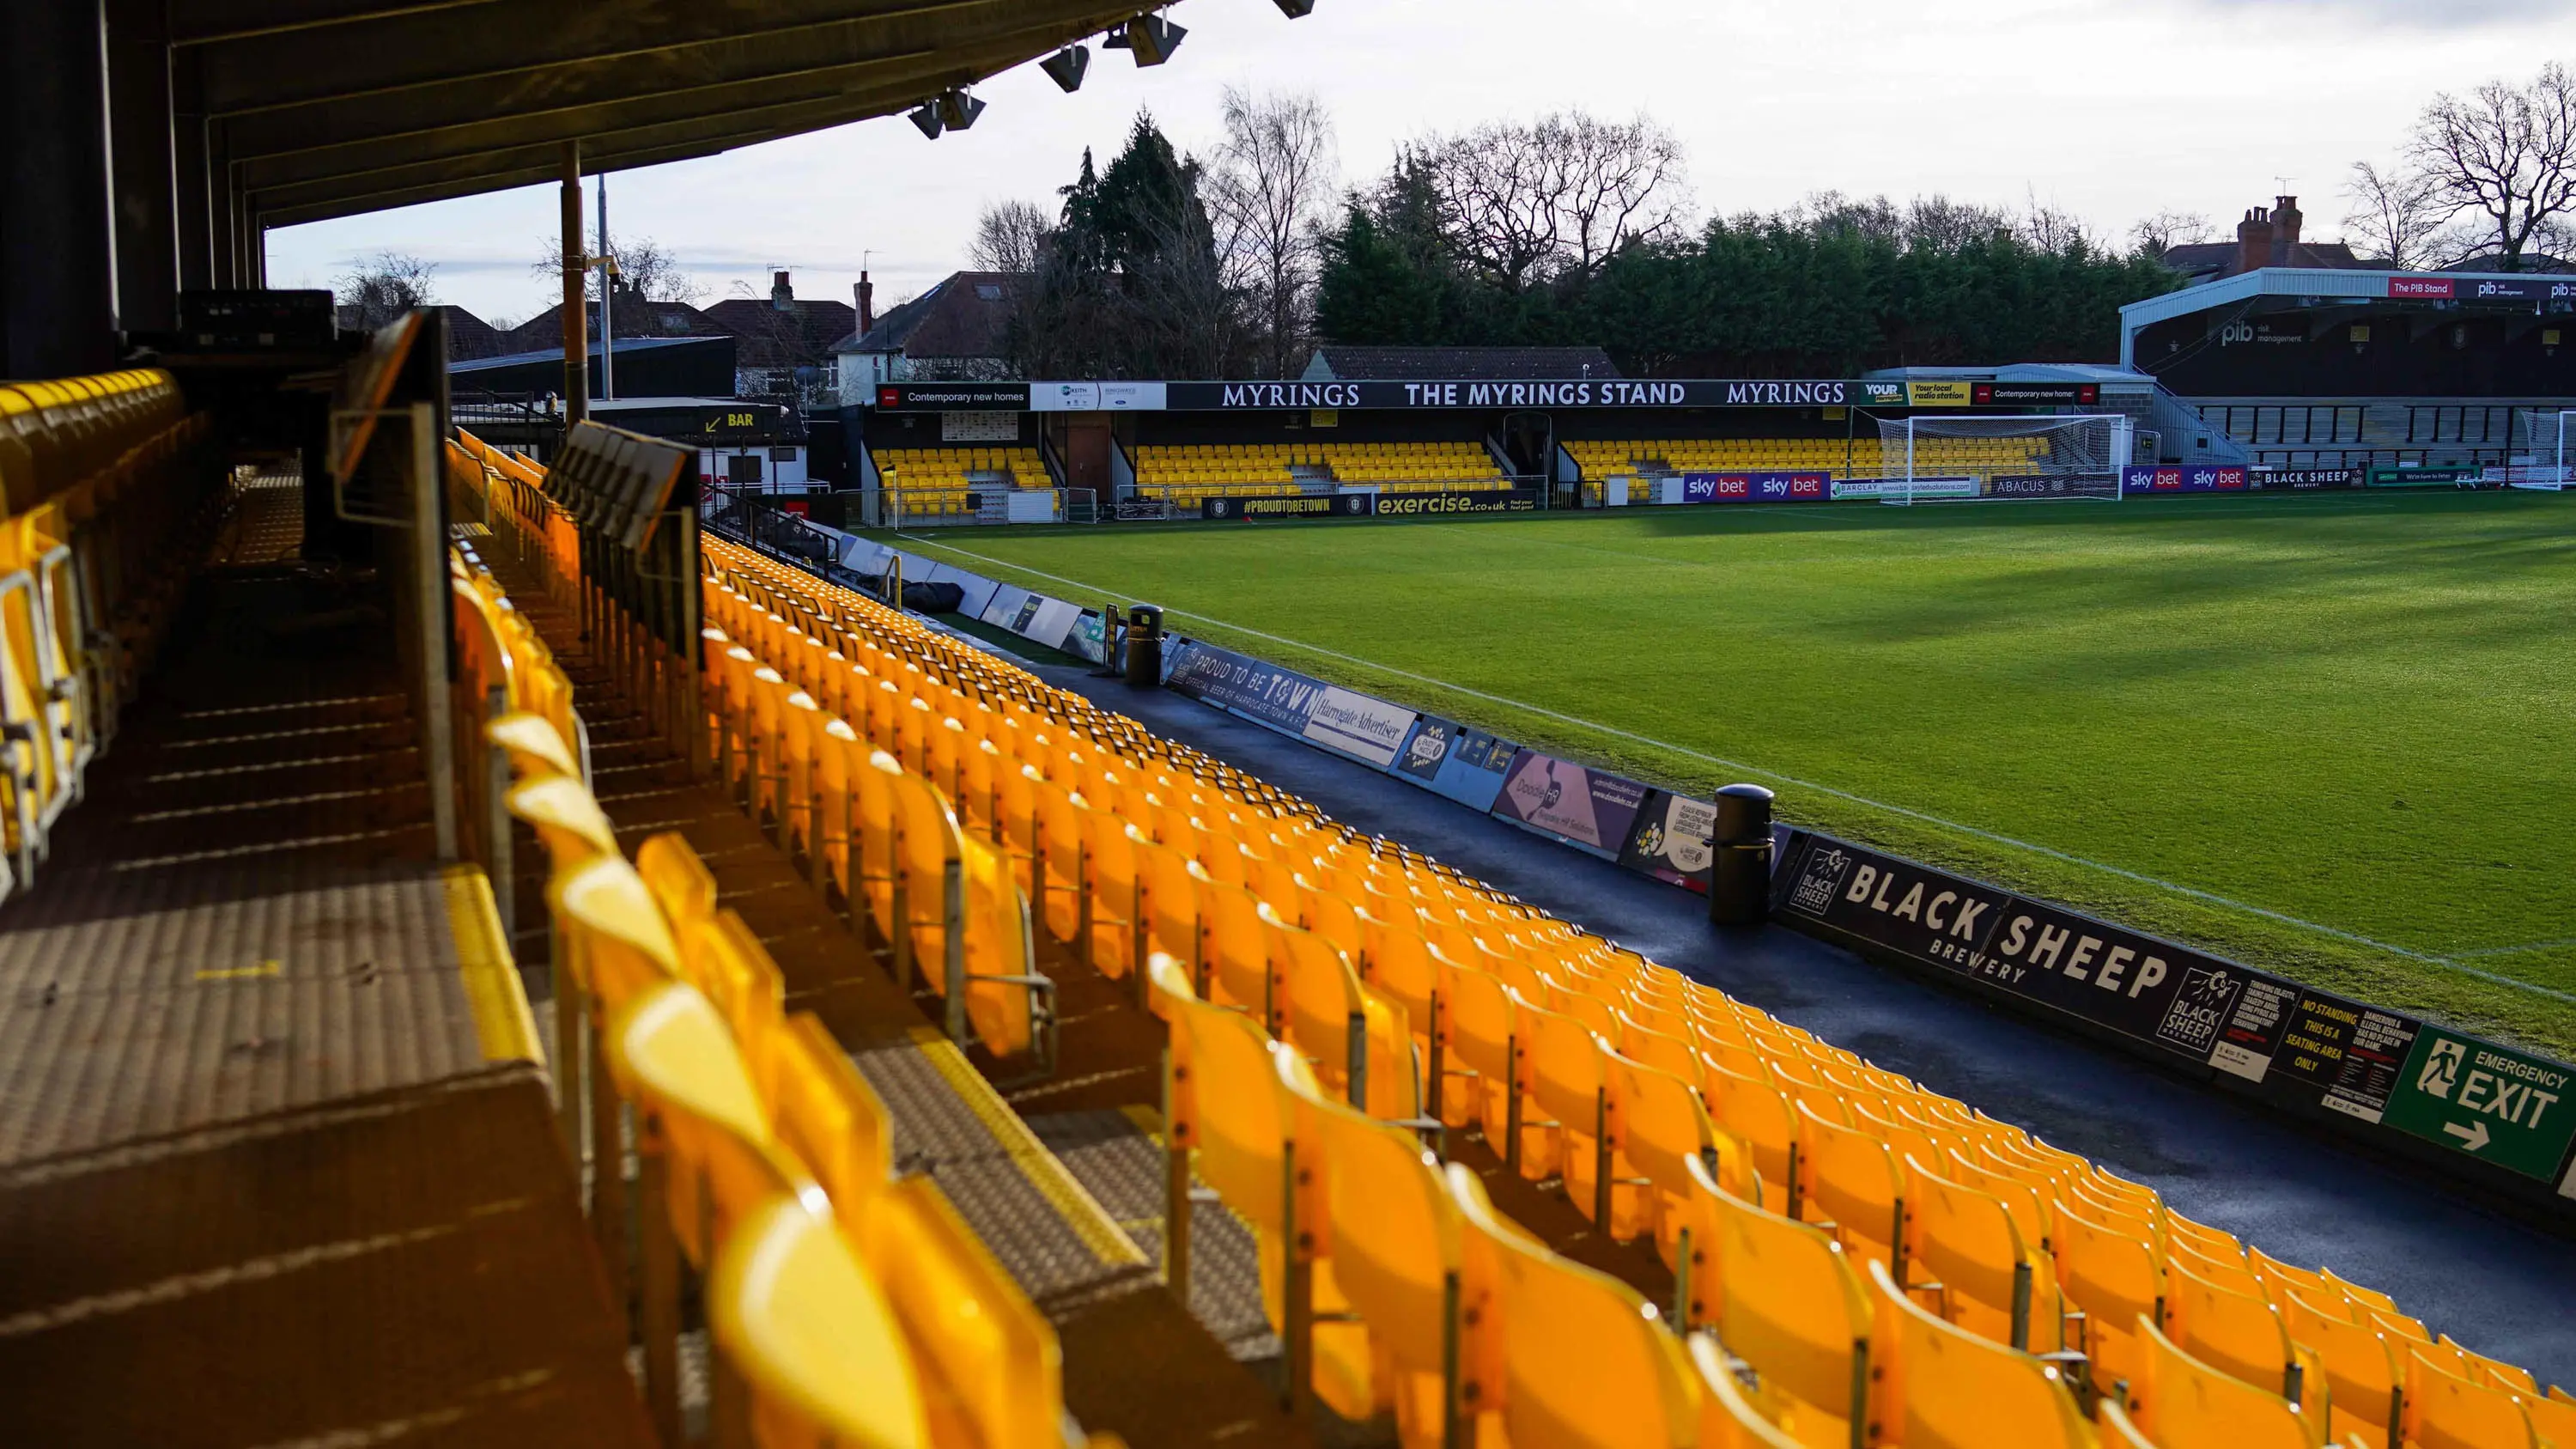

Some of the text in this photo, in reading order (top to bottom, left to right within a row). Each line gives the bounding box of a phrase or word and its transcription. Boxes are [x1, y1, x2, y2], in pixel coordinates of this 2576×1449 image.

[2394, 283, 2448, 294] The PIB Stand
[2478, 282, 2495, 297] pib
[2551, 283, 2568, 299] pib
[2221, 320, 2253, 346] pib
[2257, 335, 2302, 344] management
[908, 392, 971, 403] Contemporary
[994, 392, 1024, 401] homes
[1222, 384, 1360, 406] MYRINGS
[1404, 383, 1686, 405] THE MYRINGS STAND
[1726, 383, 1844, 404] MYRINGS
[1865, 384, 1898, 395] YOUR
[1995, 390, 2039, 399] Contemporary
[728, 413, 754, 427] BAR
[1763, 477, 1818, 496] sky bet
[1997, 480, 2044, 492] ABACUS
[2130, 471, 2178, 489] sky bet
[2193, 470, 2216, 487] sky
[2219, 470, 2240, 484] bet
[2265, 472, 2348, 483] BLACK SHEEP
[1689, 478, 1745, 496] sky bet
[1244, 498, 1330, 513] #PROUDTOBETOWN
[1378, 493, 1505, 514] exercise.co.uk
[1194, 655, 1231, 679] PROUD
[1231, 666, 1249, 685] TO
[1248, 673, 1267, 691] BE
[1316, 698, 1401, 740] Harrogate Advertiser
[1516, 778, 1559, 803] Doodle HR
[1802, 874, 1835, 894] BLACK
[1796, 886, 1829, 904] SHEEP
[1845, 864, 2168, 999] BLACK SHEEP
[1929, 939, 2026, 983] BREWERY
[2173, 1000, 2221, 1026] BLACK
[2301, 1000, 2359, 1026] NO STANDING
[2363, 1011, 2397, 1028] DANGEROUS
[2166, 1014, 2213, 1040] SHEEP
[2305, 1020, 2341, 1040] THIS IS A
[2360, 1020, 2382, 1034] ILLEGAL
[2353, 1038, 2365, 1048] OUR
[2356, 1028, 2370, 1039] HAS
[2376, 1033, 2394, 1046] PLACE
[2286, 1034, 2320, 1054] SEATING
[2319, 1045, 2343, 1061] AREA
[2293, 1056, 2319, 1072] ONLY
[2475, 1050, 2569, 1090] EMERGENCY
[2457, 1069, 2560, 1129] EXIT
